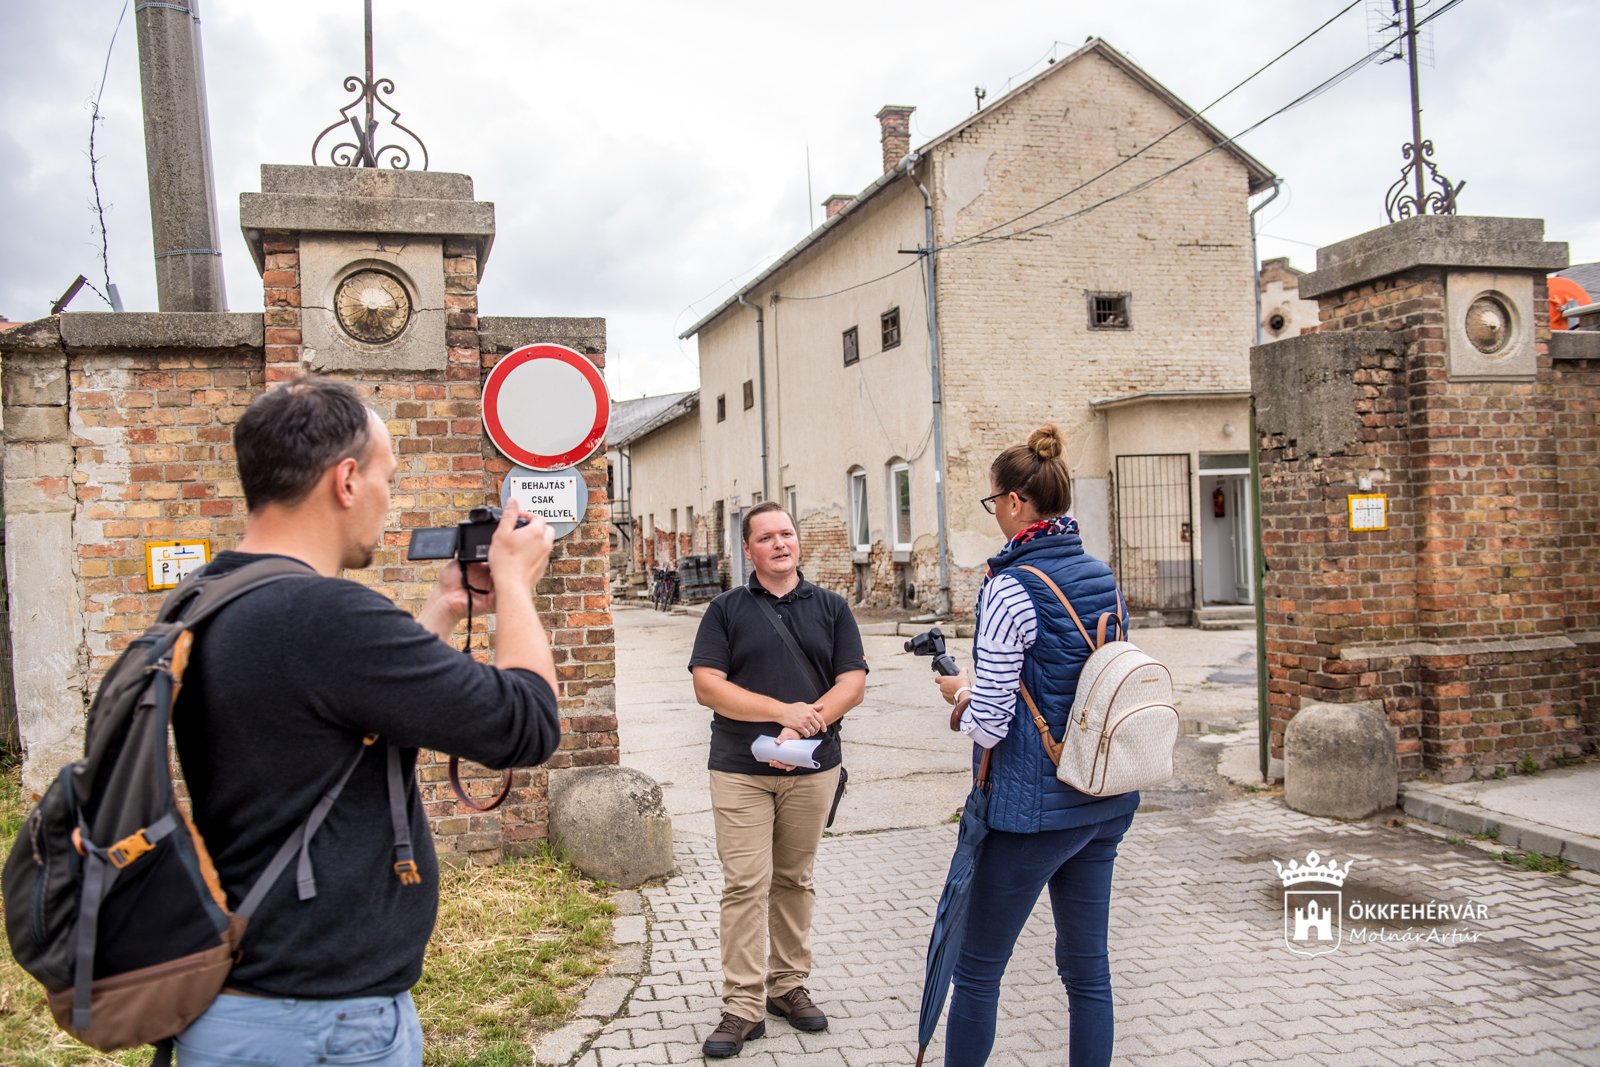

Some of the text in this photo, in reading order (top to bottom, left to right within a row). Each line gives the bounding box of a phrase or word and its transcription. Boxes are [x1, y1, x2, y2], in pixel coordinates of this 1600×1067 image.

[521, 480, 566, 490] BEHAJTÁS
[531, 495, 555, 504] CSAK
[162, 549, 170, 559] G
[162, 562, 170, 573] 2
